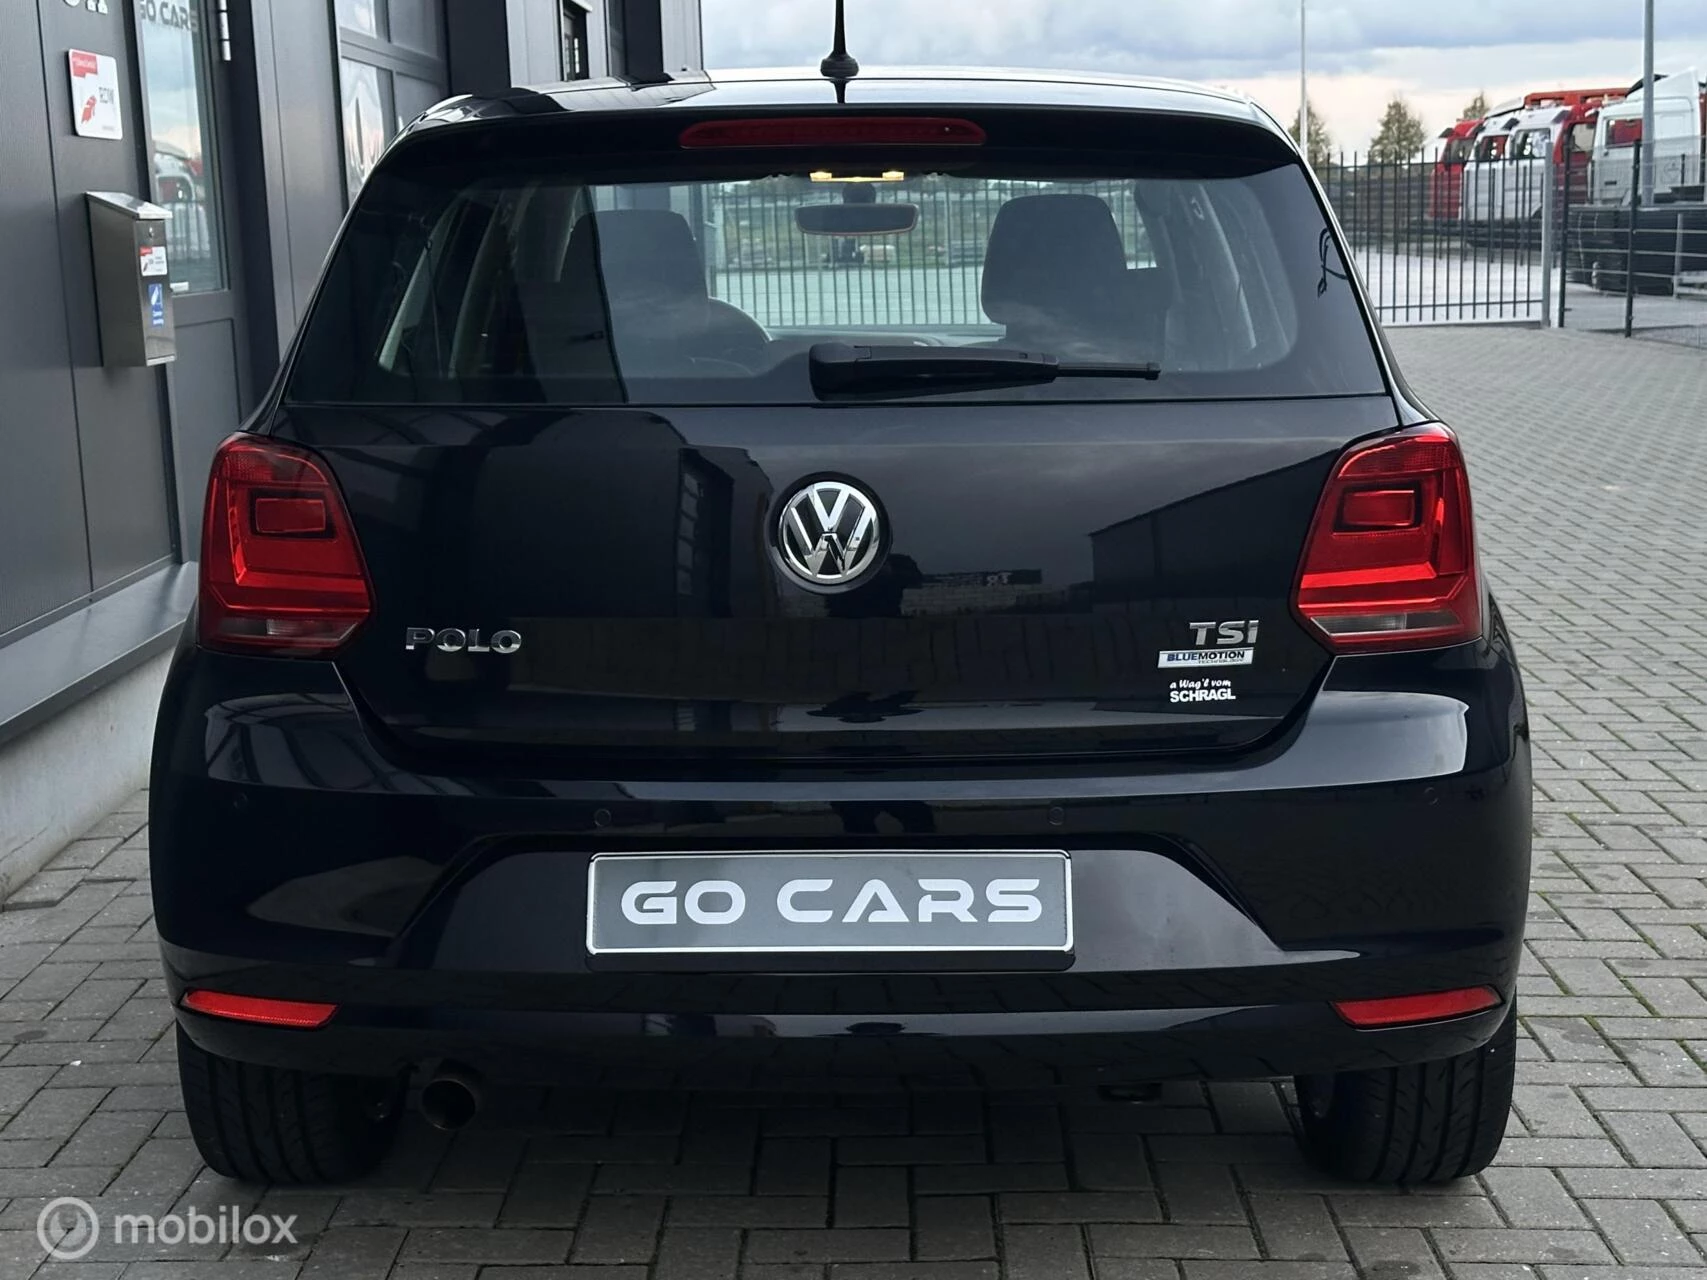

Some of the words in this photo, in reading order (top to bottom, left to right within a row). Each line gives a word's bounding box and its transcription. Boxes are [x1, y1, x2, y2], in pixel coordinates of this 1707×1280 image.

[405, 627, 522, 654] POLO
[1167, 651, 1245, 662] BLUEMOTION
[1211, 679, 1231, 688] vom
[1169, 688, 1236, 703] SCHRAGL
[621, 880, 746, 924] GO
[777, 879, 1043, 923] CARS
